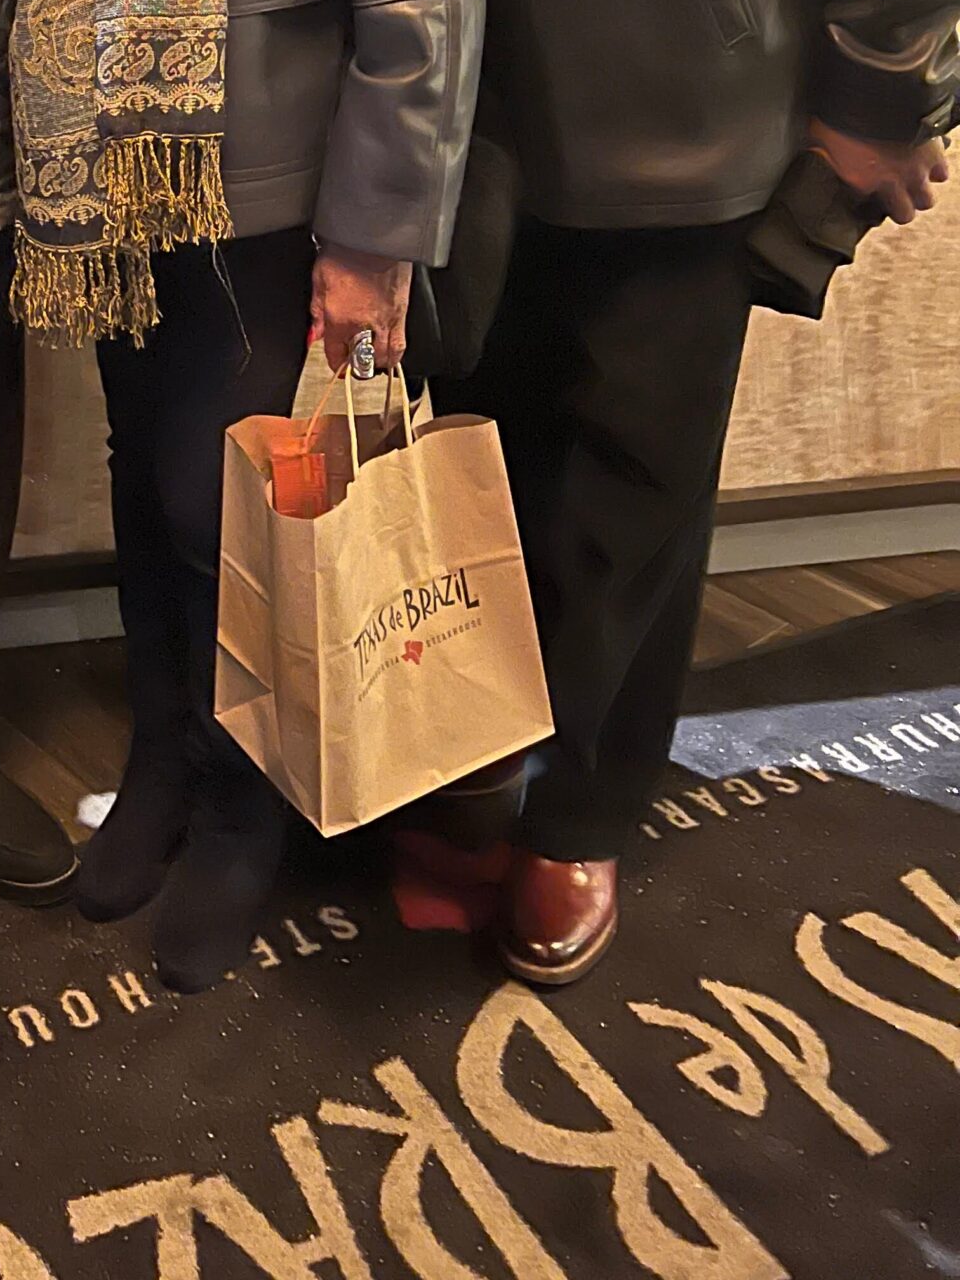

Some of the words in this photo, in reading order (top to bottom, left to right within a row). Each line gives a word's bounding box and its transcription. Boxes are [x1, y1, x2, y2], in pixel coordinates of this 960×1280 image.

[353, 606, 387, 681] TEXAS
[389, 605, 404, 632] de
[627, 978, 890, 1156] de
